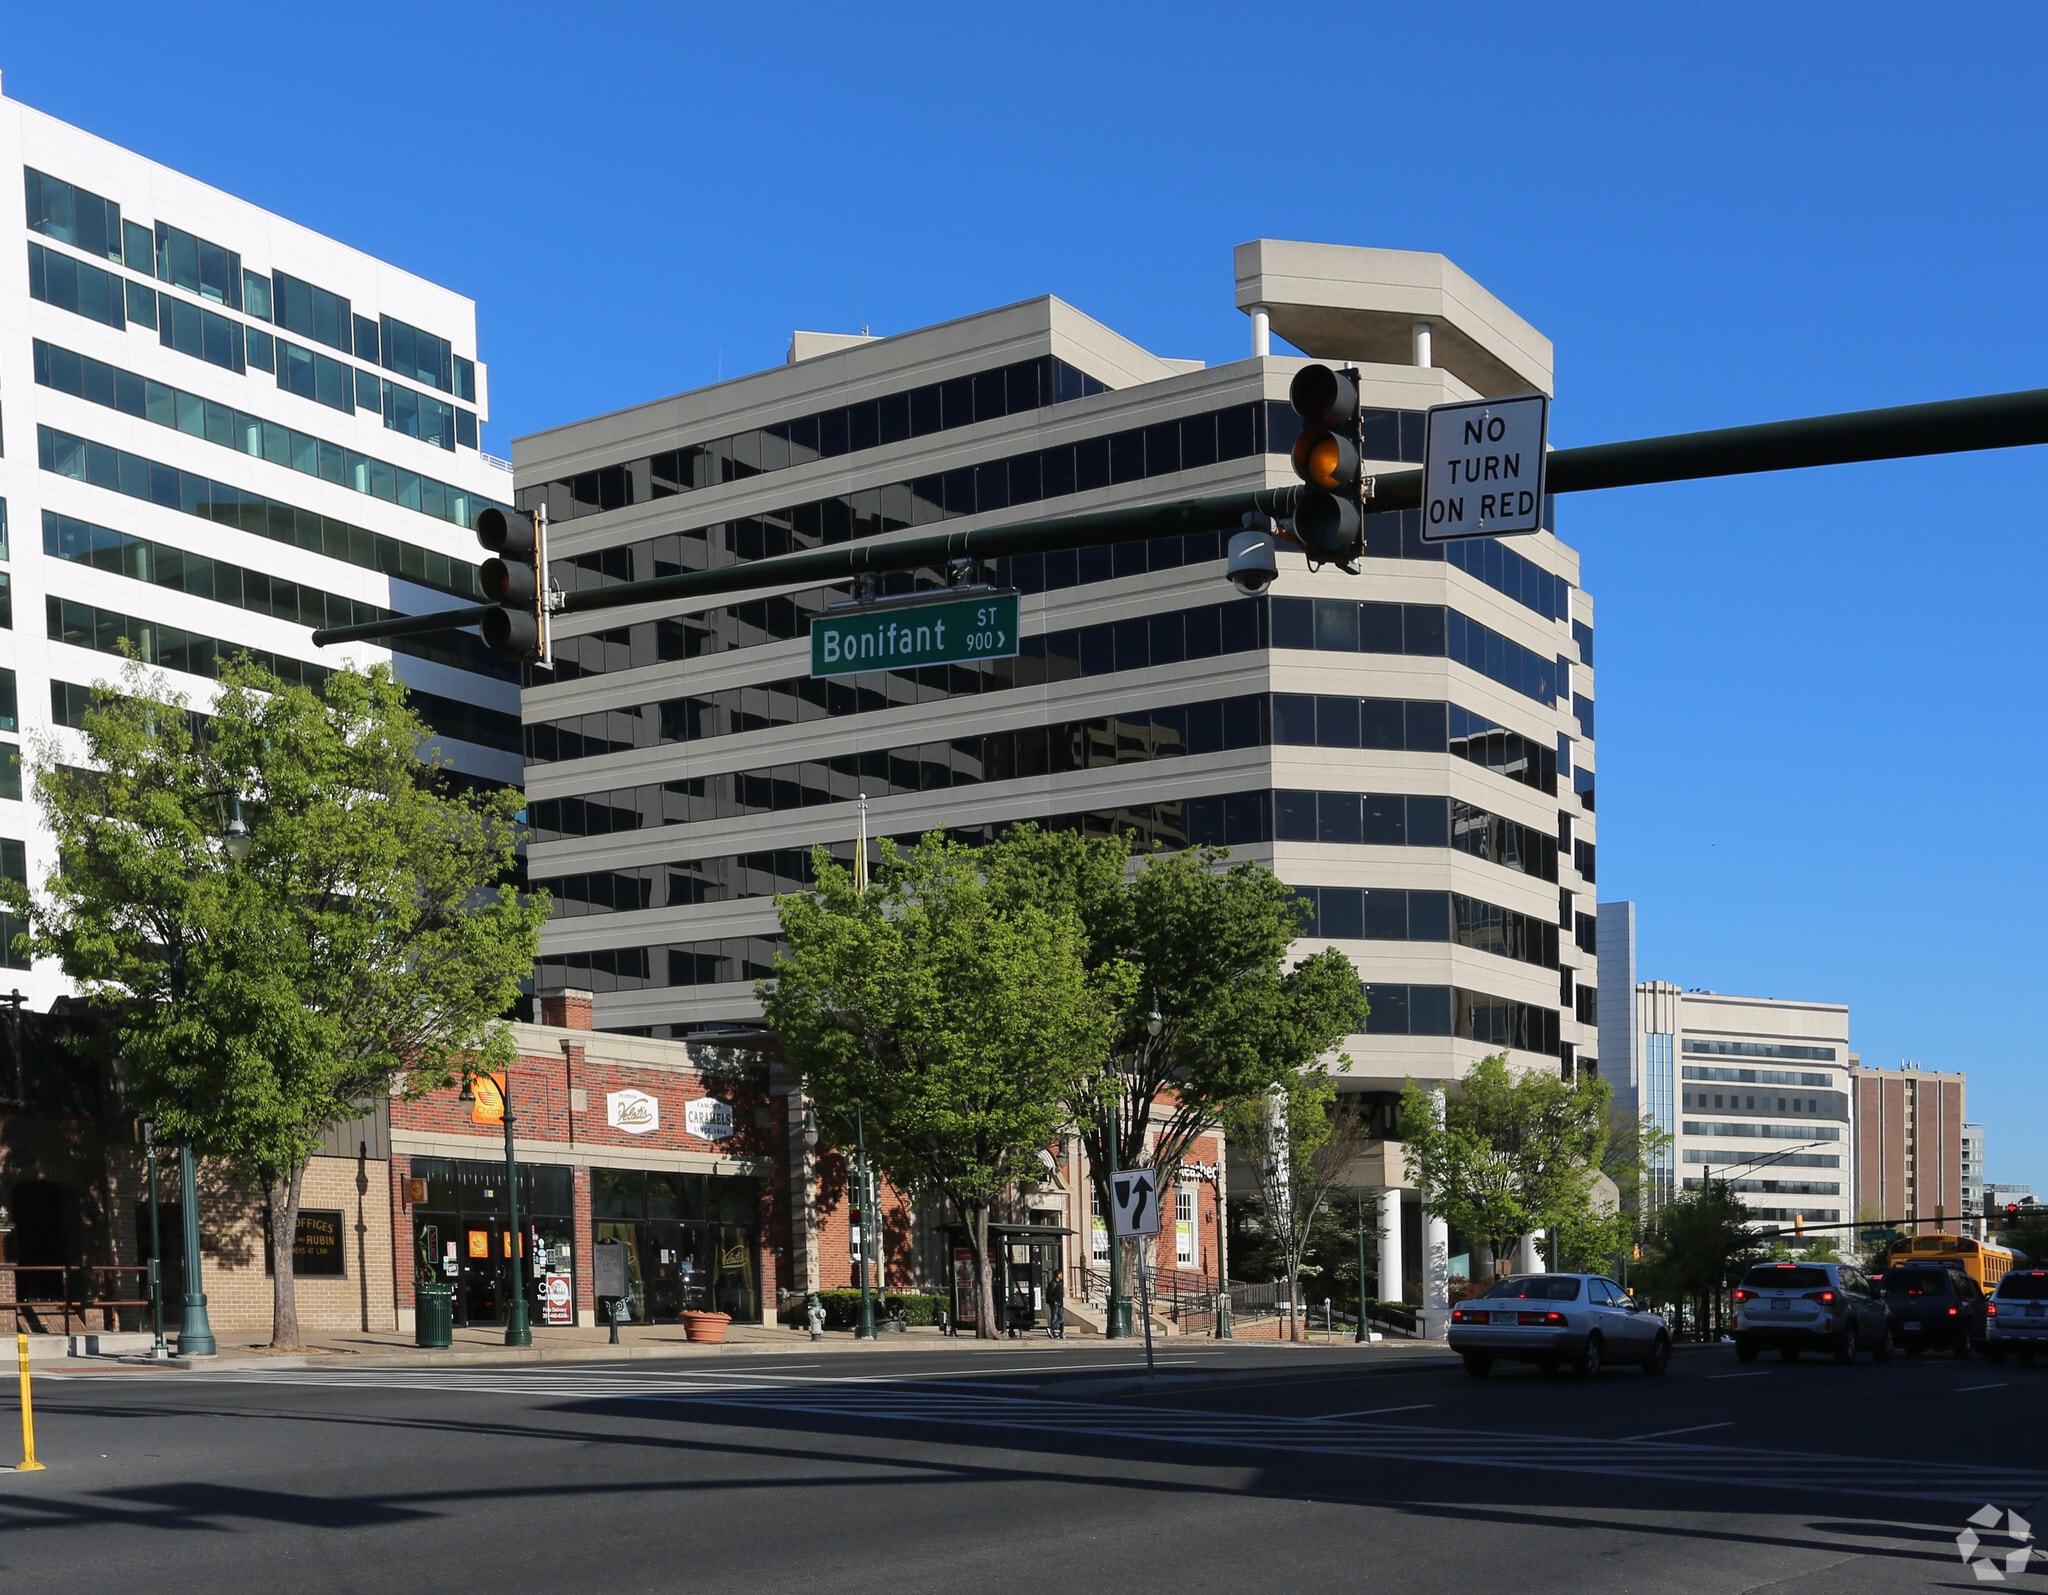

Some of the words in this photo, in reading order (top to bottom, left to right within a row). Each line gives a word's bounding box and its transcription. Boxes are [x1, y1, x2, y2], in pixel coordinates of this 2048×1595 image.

[1464, 417, 1505, 445] NO
[1448, 453, 1520, 485] TURN
[1430, 497, 1463, 524] ON
[1480, 491, 1533, 518] RED
[977, 607, 997, 627] ST
[824, 619, 945, 662] Bonifant
[966, 631, 992, 651] 900
[697, 1102, 721, 1110] FAMOUS
[688, 1111, 731, 1125] CARAMELS
[693, 1127, 711, 1135] SINCE
[1180, 1159, 1220, 1179] leashed
[296, 1218, 334, 1233] OFFICES
[306, 1235, 334, 1245] RUBIN
